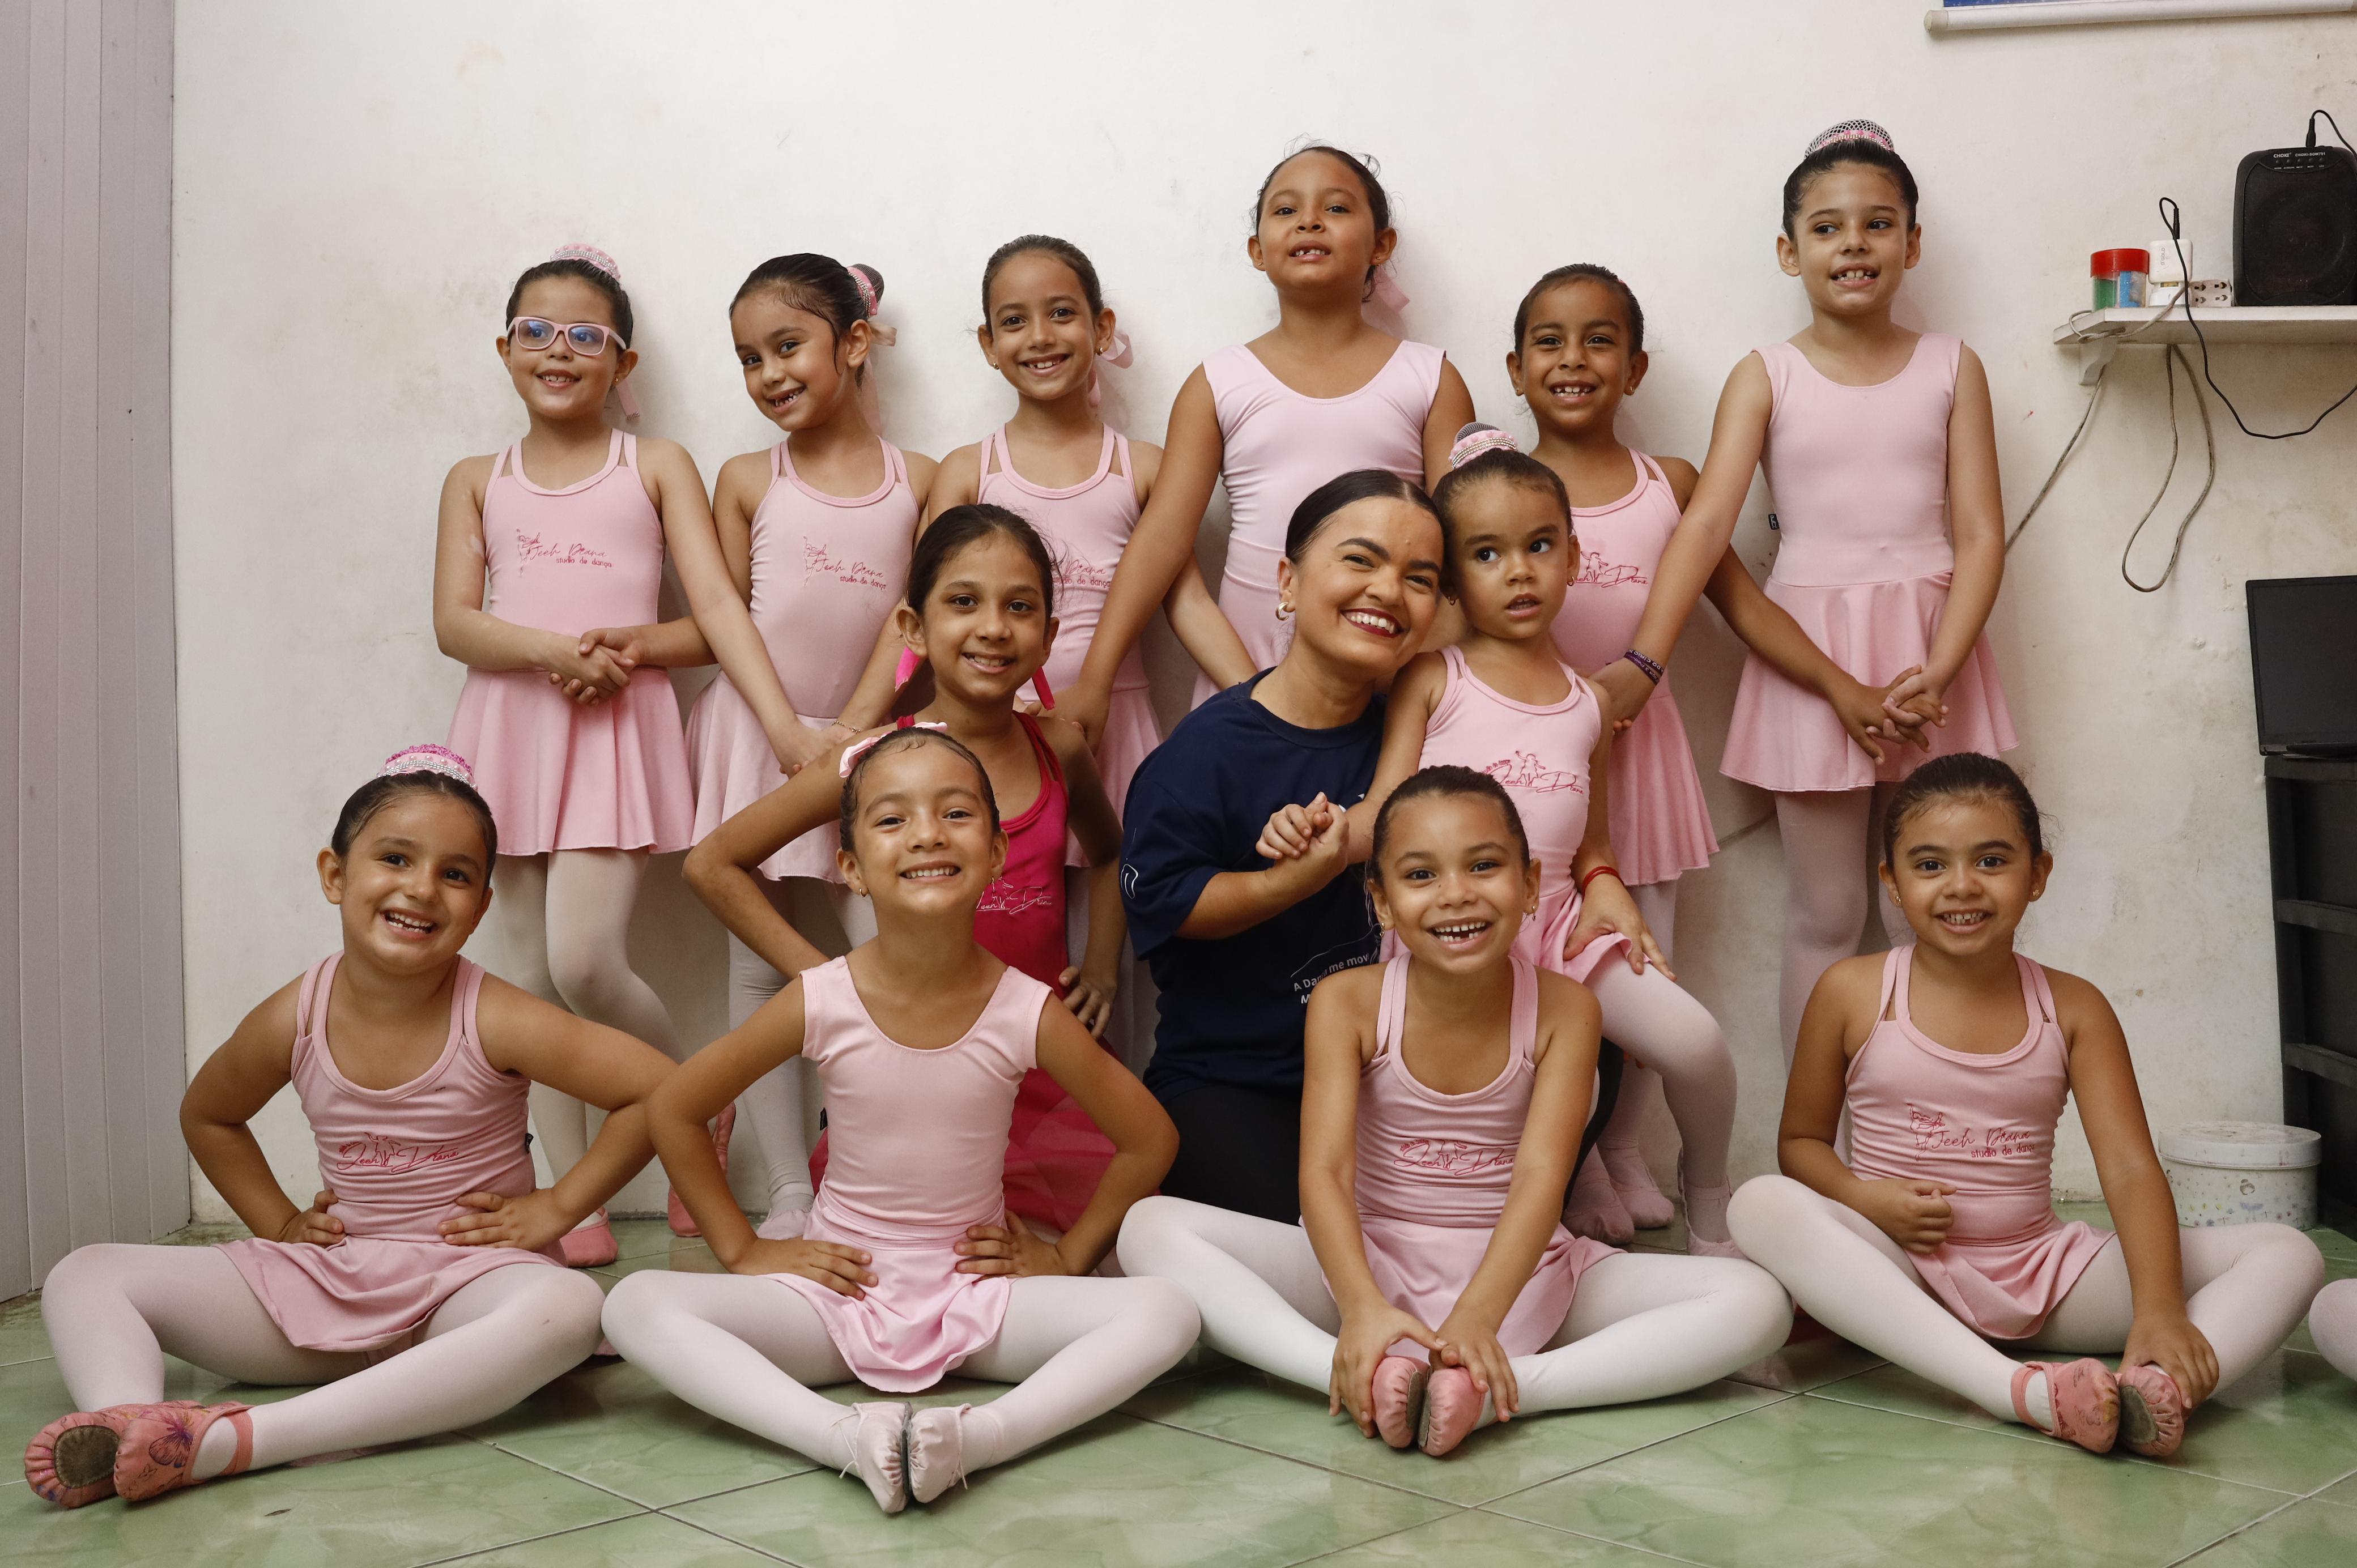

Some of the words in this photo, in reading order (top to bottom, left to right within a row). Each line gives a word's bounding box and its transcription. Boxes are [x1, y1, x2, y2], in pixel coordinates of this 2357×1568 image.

[568, 543, 607, 557] Diana
[592, 558, 612, 568] dança
[840, 575, 857, 584] studio
[870, 579, 887, 590] dança
[1077, 576, 1086, 585] de
[1090, 576, 1111, 588] dança
[1294, 982, 1302, 991] A
[1329, 961, 1345, 973] me
[1347, 953, 1369, 966] mov
[1986, 1127, 2031, 1147] Diana
[1971, 1145, 1997, 1158] studio
[2002, 1145, 2013, 1156] de
[2016, 1143, 2035, 1154] dança
